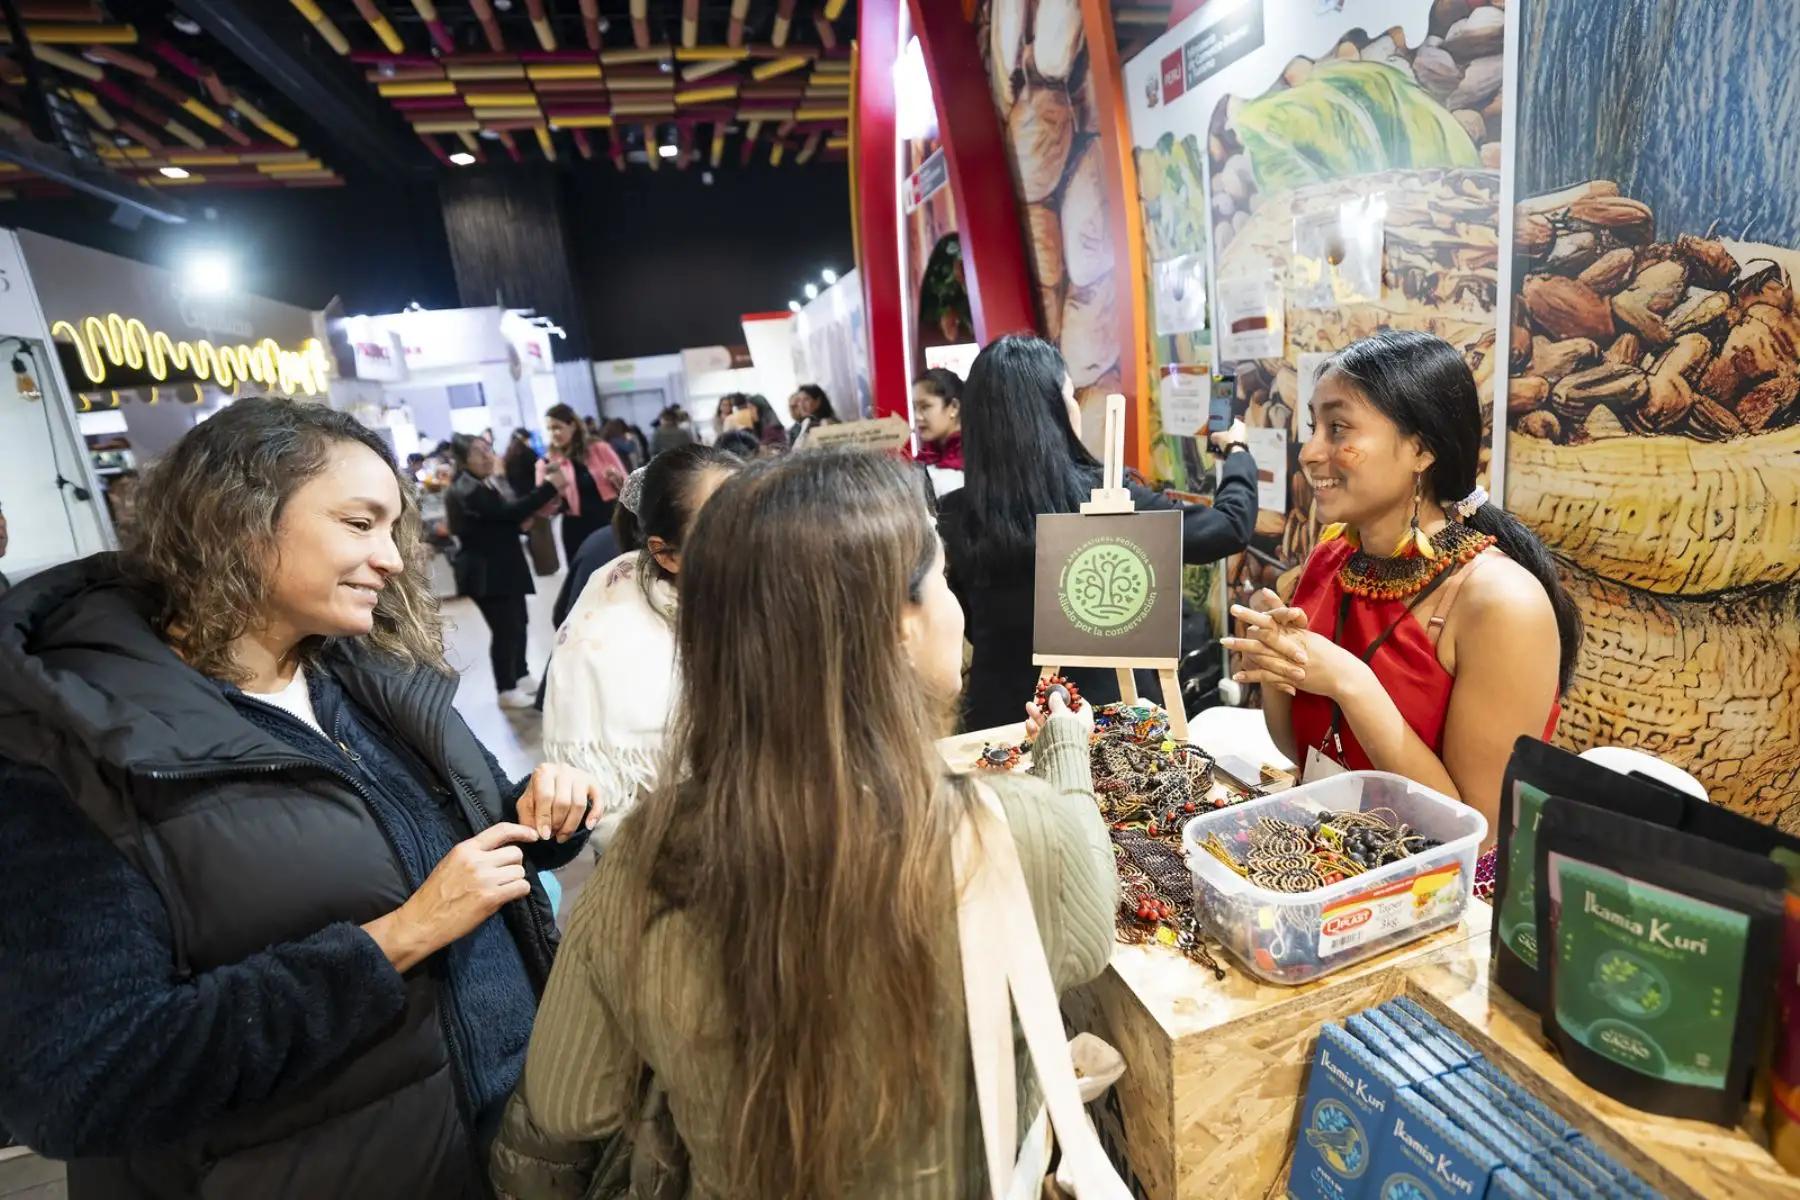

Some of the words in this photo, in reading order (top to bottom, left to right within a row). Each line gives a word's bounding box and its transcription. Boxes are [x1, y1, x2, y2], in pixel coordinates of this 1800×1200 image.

[1057, 592, 1076, 622] Aliado
[1074, 620, 1092, 633] por
[1093, 626, 1103, 637] la
[1649, 918, 1708, 955] Kuri
[1356, 1078, 1386, 1112] Kuri
[1436, 1153, 1475, 1195] Kuri
